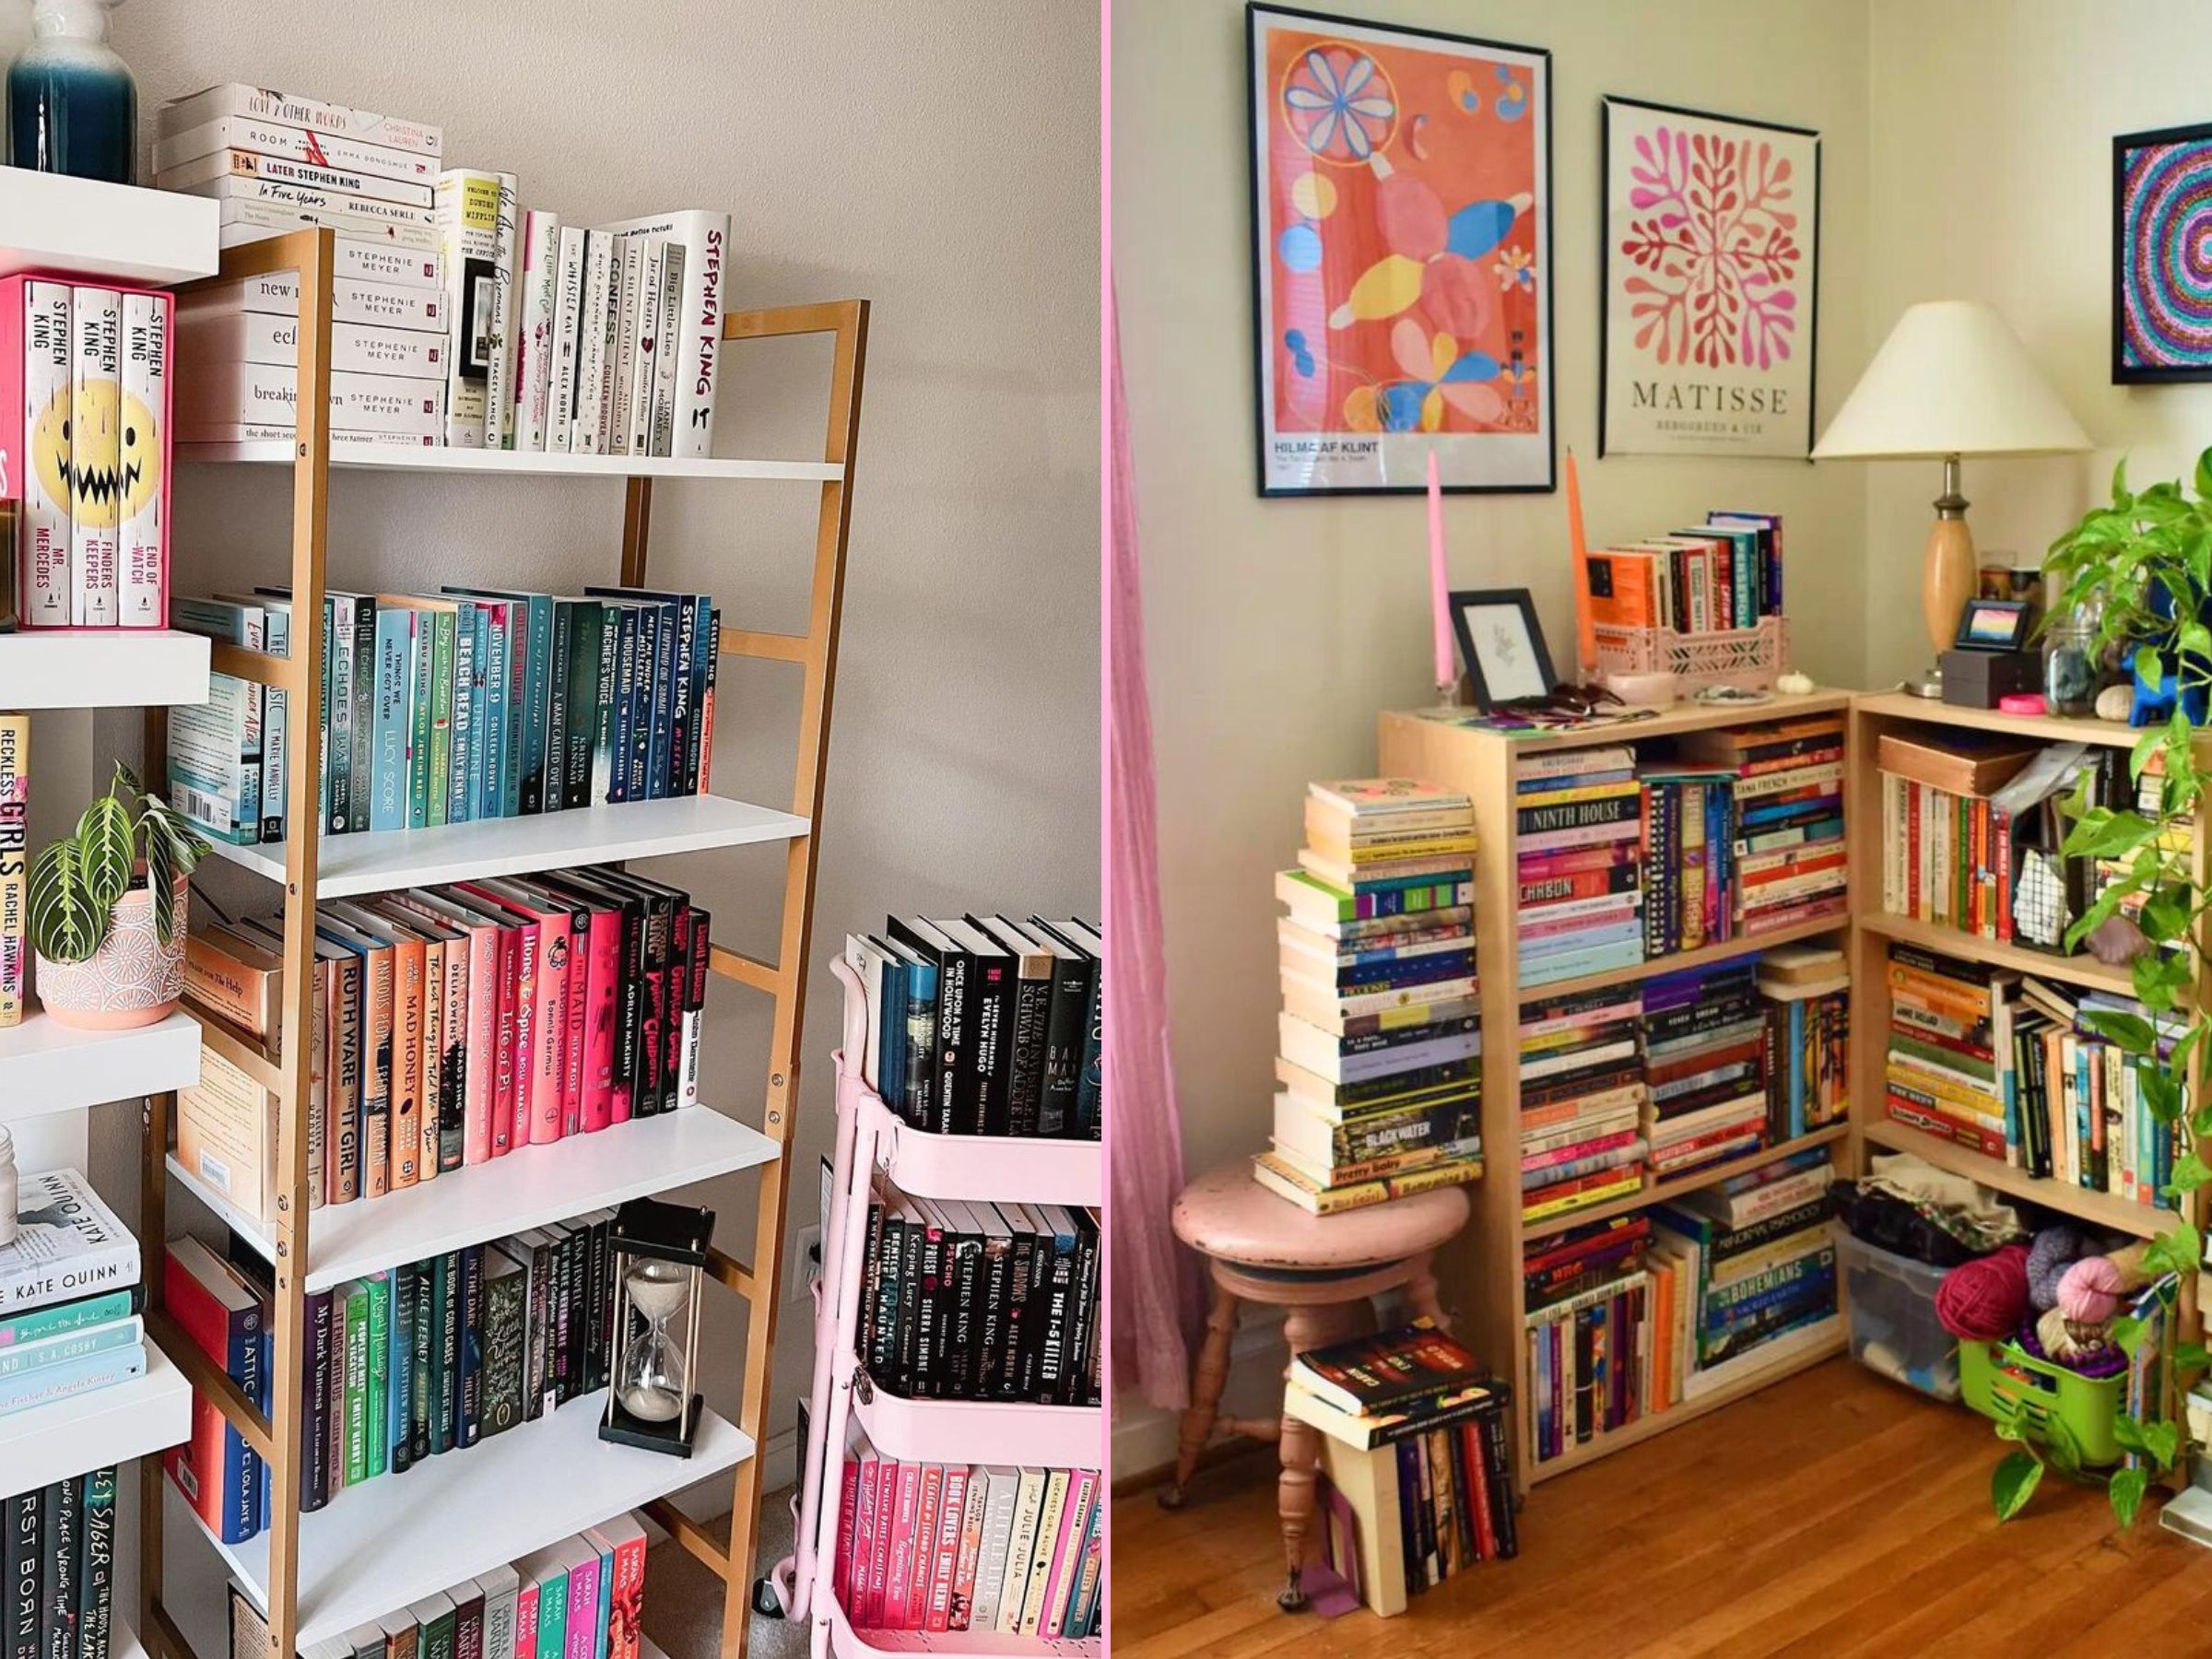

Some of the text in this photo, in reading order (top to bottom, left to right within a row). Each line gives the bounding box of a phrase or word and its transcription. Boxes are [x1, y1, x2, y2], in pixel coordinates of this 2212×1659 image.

[249, 131, 288, 147] ROOM
[383, 121, 424, 138] CHRISTINA
[266, 162, 360, 189] LATER STEPHEN KING
[348, 202, 415, 220] REBECCA SERLE
[348, 250, 413, 266] STEPHENIE
[361, 262, 400, 274] MEYER
[261, 282, 290, 296] new
[351, 292, 417, 307] STEPHENIE
[364, 303, 404, 315] MEYER
[606, 258, 620, 345] CONFESS
[622, 249, 637, 366] THE SILENT PATIENT
[696, 229, 723, 395] STEPHEN KING
[33, 314, 49, 348] KING
[53, 301, 66, 366] STEPHEN
[664, 272, 678, 357] Big Little Lies
[84, 323, 100, 357] KING
[100, 310, 116, 372] STEPHEN
[132, 326, 147, 361] KING
[149, 315, 163, 377] STEPHEN
[355, 339, 418, 353] STEPHENIE
[368, 350, 405, 361] MEYER
[350, 394, 414, 406] STEPHENIE
[363, 404, 401, 414] MEYER
[655, 389, 665, 442] MORIARTY
[663, 401, 671, 431] LIANE
[1631, 381, 1788, 414] MATISSE
[1321, 442, 1336, 453] AF
[1341, 441, 1378, 453] KLINT
[36, 527, 49, 588] MERCEDES
[52, 547, 65, 570] MR.
[87, 539, 100, 589] KEEPERS
[101, 541, 112, 588] FINDERS
[132, 546, 144, 584] WATCH
[146, 546, 158, 585] END OF
[384, 638, 393, 668] NEVER
[709, 618, 718, 661] CELESTE
[393, 653, 402, 704] THINGS WE
[673, 605, 693, 776] STEPHEN KING MISERY
[335, 647, 348, 772] ECHOES WAR
[382, 696, 391, 720] OVER
[453, 638, 472, 798] BEACH READ EMILY HENRY
[488, 625, 502, 792] NOVEMBER 9 COLLEEN HOOVER
[382, 730, 396, 814] LUCY SCORE
[577, 736, 586, 782] KRISTIN
[1, 729, 26, 875] RECKLESS GIRLS
[1757, 777, 1788, 792] FRENCH
[1534, 800, 1621, 830] NINTH HOUSE
[3, 883, 18, 993] RACHEL HAWKINS
[344, 967, 358, 1013] RUTH
[515, 935, 535, 1049] Honey Spice
[942, 968, 954, 1039] IN HOLLYWOOD
[1018, 984, 1034, 1043] SCHWAB
[342, 1019, 356, 1087] WARE
[406, 995, 417, 1094] MAD HONEY
[545, 1000, 555, 1076] Bonnie Garmus
[568, 982, 584, 1092] MAID NITA PROSE
[977, 998, 992, 1073] EVELYN HUGO
[943, 1071, 953, 1107] QUENTIN
[345, 1112, 355, 1123] IT
[1366, 1122, 1430, 1147] BLACKWATER
[340, 1127, 355, 1176] GIRL
[1335, 1166, 1370, 1181] Pretty
[39, 1176, 110, 1244] KATE QUINN
[881, 1239, 891, 1274] LITTLE
[889, 1232, 900, 1280] BENTLEY
[904, 1234, 920, 1308] Keeping Lucy
[17, 1264, 118, 1299] KATE QUINN
[466, 1258, 477, 1327] IN THE DARK
[957, 1253, 974, 1343] STEPHEN KING
[984, 1256, 1003, 1345] STEPHEN KING
[1731, 1261, 1804, 1303] BOHEMIANS
[418, 1277, 430, 1363] ALICE FEENEY
[875, 1295, 888, 1364] HAUNTED
[918, 1244, 938, 1371] PRIEST SIERRA SIMONE
[243, 1346, 256, 1392] ATTIC
[314, 1306, 328, 1410] My Dark Vanessa
[348, 1345, 358, 1388] VACATION
[357, 1322, 366, 1393] PEOPLE WE MEET
[399, 1357, 409, 1441] MATTHEW PERRY
[464, 1377, 474, 1416] HILLIER
[351, 1397, 361, 1464] EMILY HENRY
[241, 1468, 251, 1523] LOLA JAYE
[975, 1496, 983, 1523] TAYLOR
[90, 1507, 113, 1566] SAGER
[934, 1476, 963, 1612] BOOK LOVERS EMILY HENRY
[1014, 1509, 1033, 1579] JULIE JULIA
[630, 1547, 640, 1582] SARAH
[529, 1600, 537, 1634] SARAH
